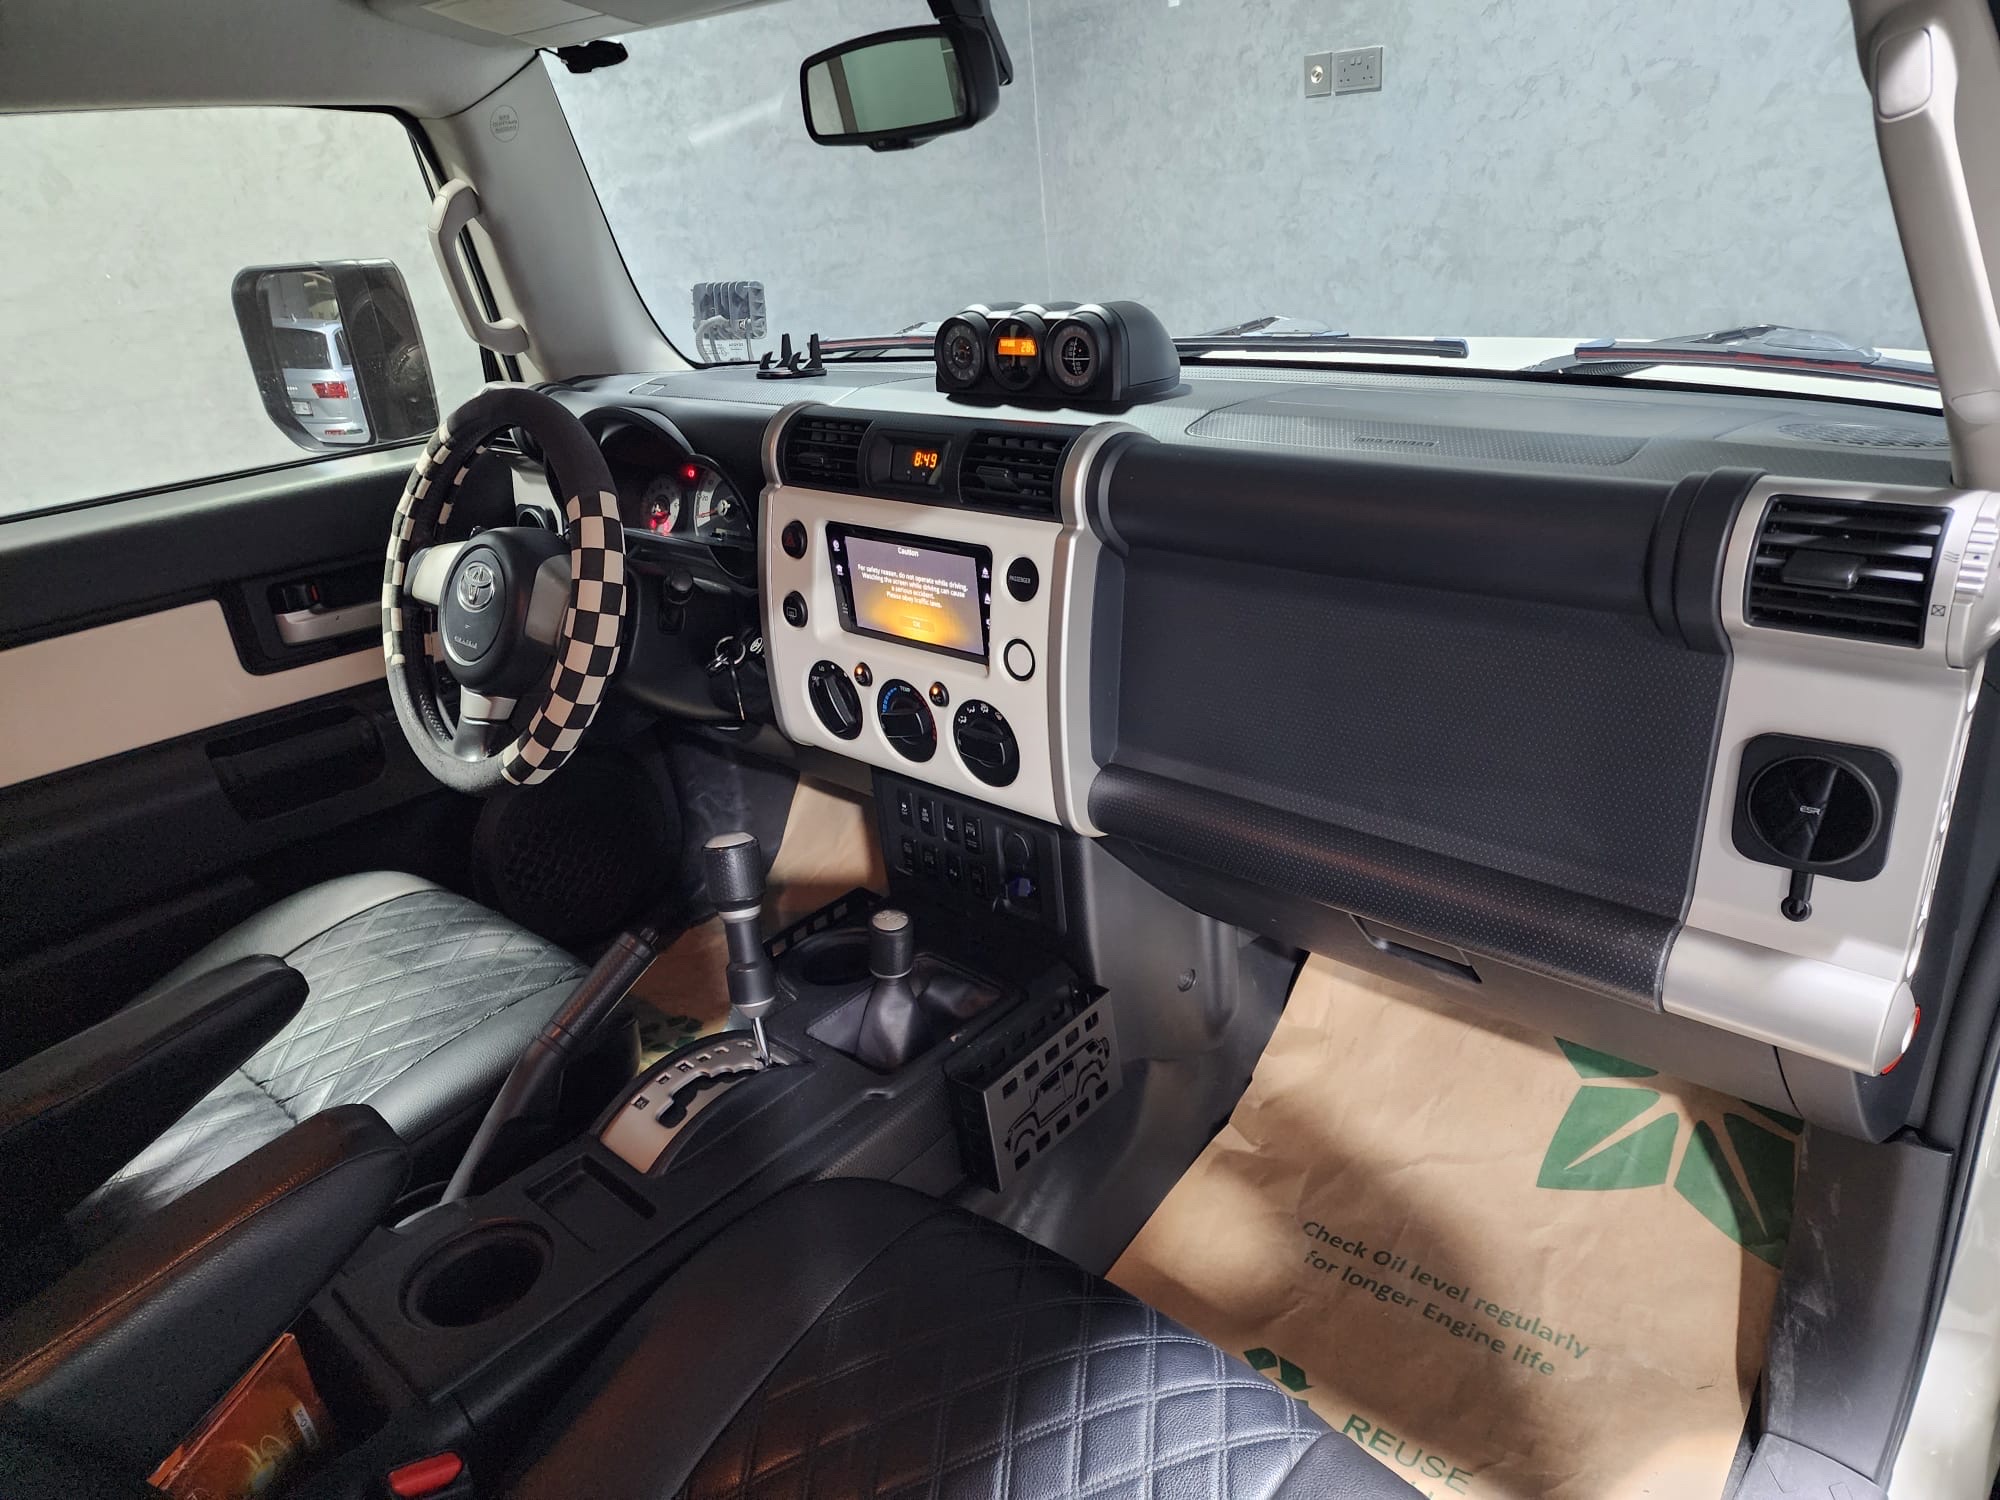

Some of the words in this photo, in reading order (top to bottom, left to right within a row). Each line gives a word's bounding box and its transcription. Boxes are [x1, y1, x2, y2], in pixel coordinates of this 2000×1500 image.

[914, 451, 938, 469] 8:49
[1303, 1221, 1368, 1259] Check
[1373, 1250, 1407, 1273] Oil
[1410, 1265, 1470, 1303] level
[1473, 1297, 1590, 1359] regularly
[1304, 1250, 1339, 1274] for
[1341, 1267, 1419, 1308] longer
[1422, 1302, 1506, 1354] Engine
[1512, 1344, 1555, 1376] life
[1342, 1414, 1474, 1496] REUSE
